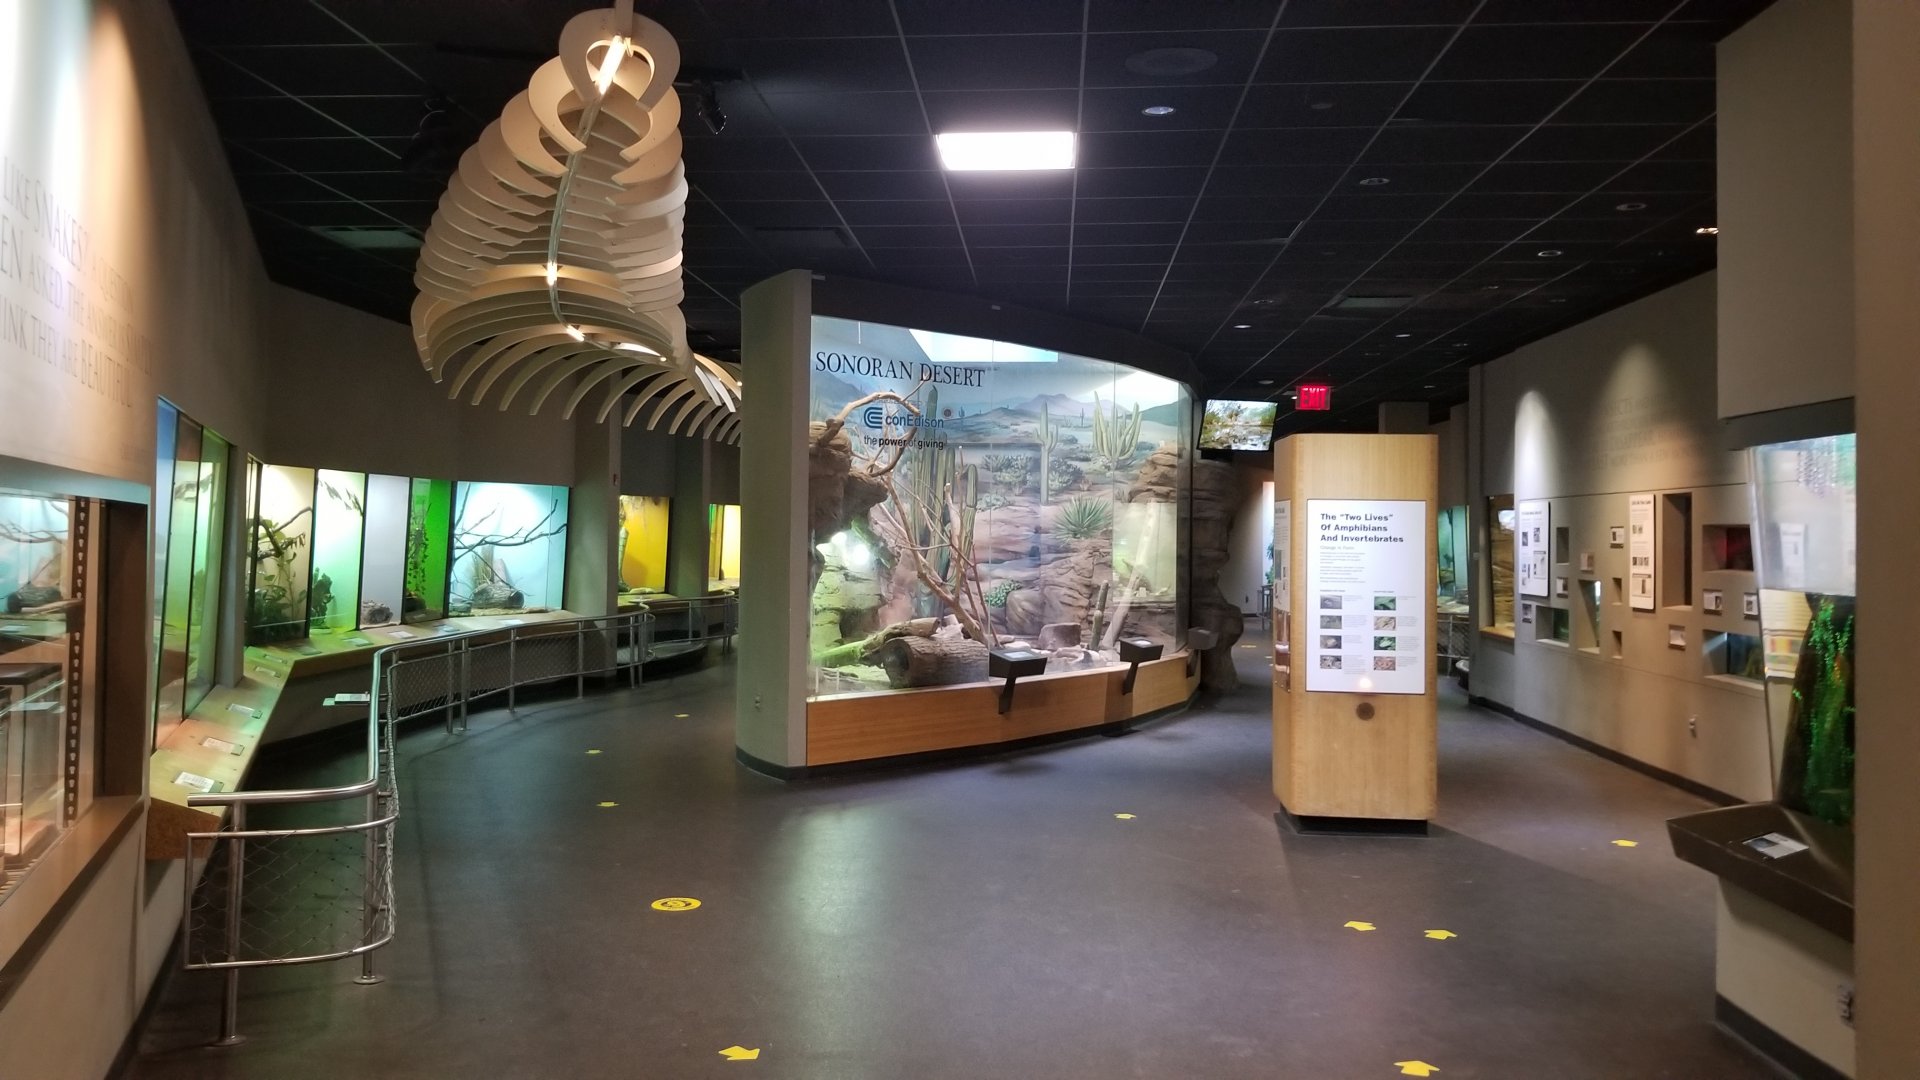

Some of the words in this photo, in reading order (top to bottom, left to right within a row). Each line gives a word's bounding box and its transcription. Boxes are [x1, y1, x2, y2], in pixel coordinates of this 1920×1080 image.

[3, 156, 30, 220] LIKE
[34, 178, 91, 273] SNAKES?
[67, 280, 85, 328] THE
[0, 293, 27, 351] INK
[31, 314, 59, 369] THEY
[81, 338, 133, 409] BEAUTIFUL
[815, 351, 914, 381] SONORAN
[919, 362, 986, 388] DESERT
[1301, 386, 1327, 409] EXIT
[885, 414, 944, 429] conEdison
[864, 435, 877, 446] the
[879, 438, 907, 448] power
[908, 437, 917, 448] of
[918, 439, 944, 450] giving
[1320, 513, 1337, 521] The
[1340, 513, 1362, 521] "Two
[1364, 513, 1394, 522] Lives"
[1334, 524, 1388, 533] Amphibians
[1320, 534, 1338, 542] And
[1341, 535, 1404, 543] Invertebrates
